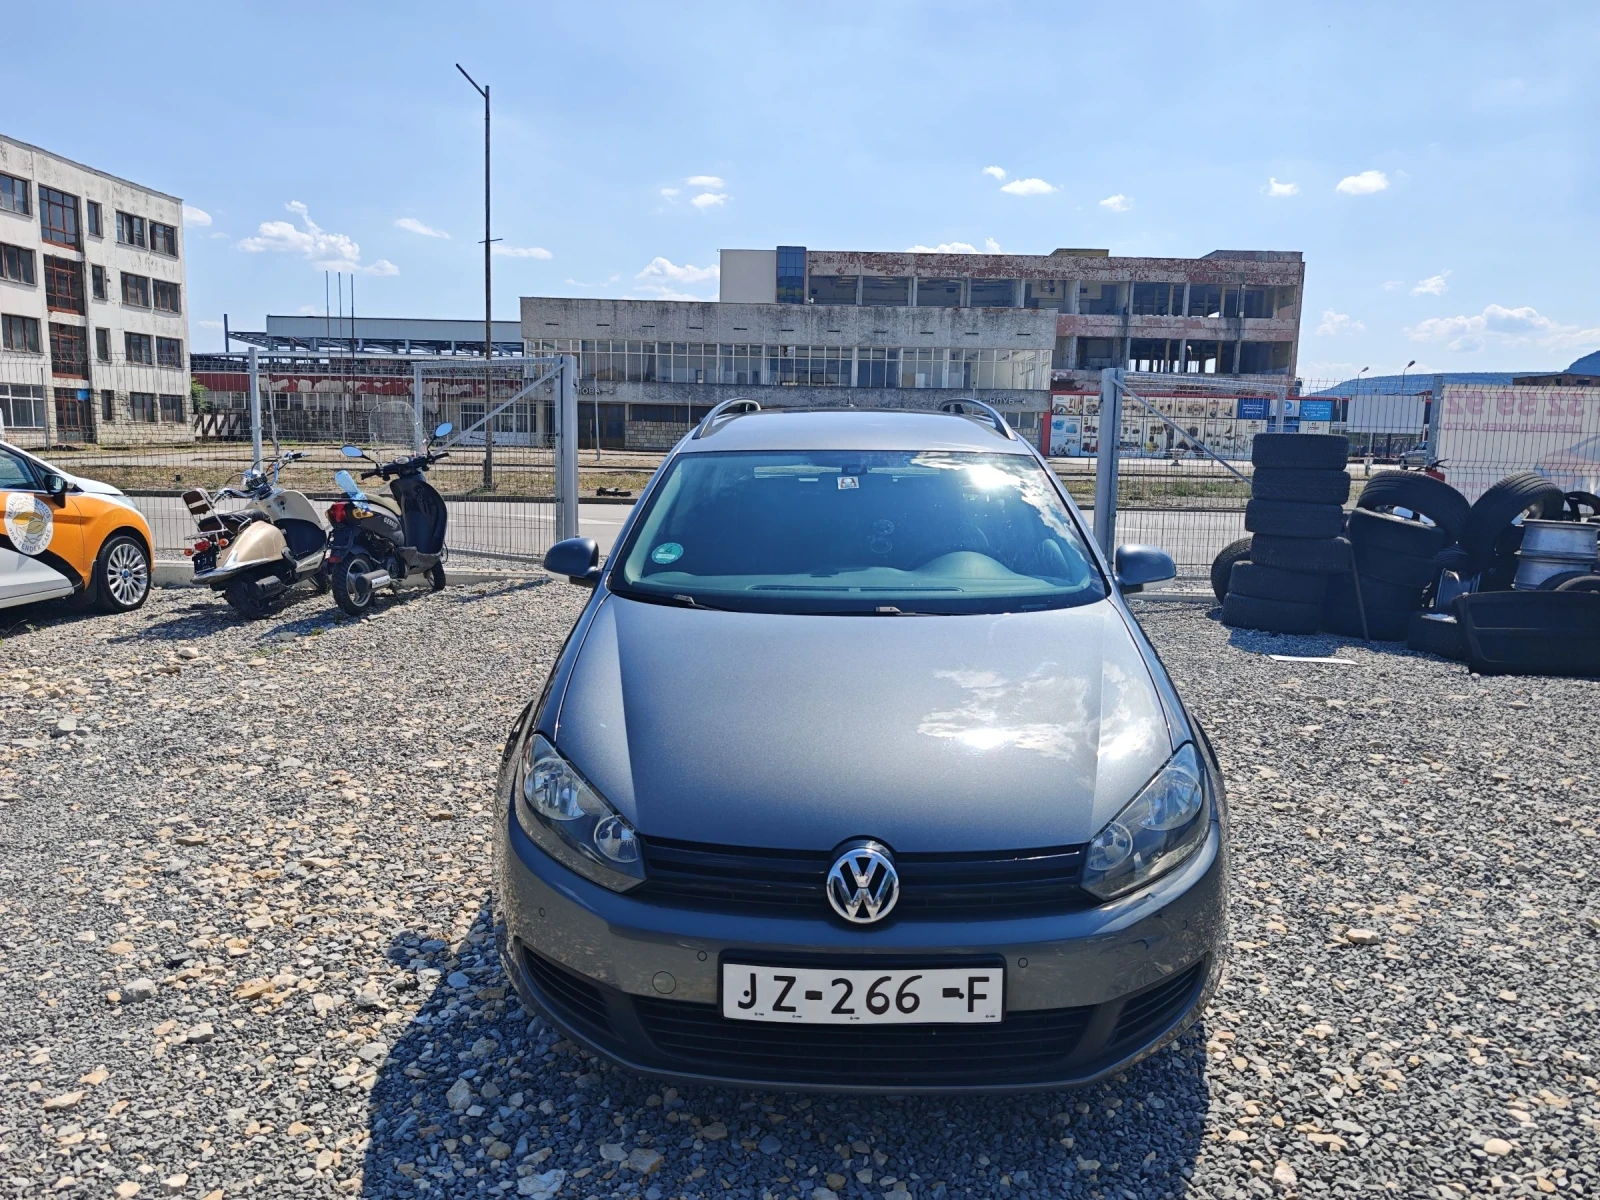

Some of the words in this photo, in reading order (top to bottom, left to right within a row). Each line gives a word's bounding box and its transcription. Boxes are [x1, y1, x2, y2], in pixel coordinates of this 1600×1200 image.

[989, 397, 1015, 405] КЛУБ
[9, 528, 18, 541] and
[19, 541, 42, 552] TENDER
[41, 530, 52, 546] CARE
[665, 545, 674, 554] 4
[827, 848, 900, 924] VW
